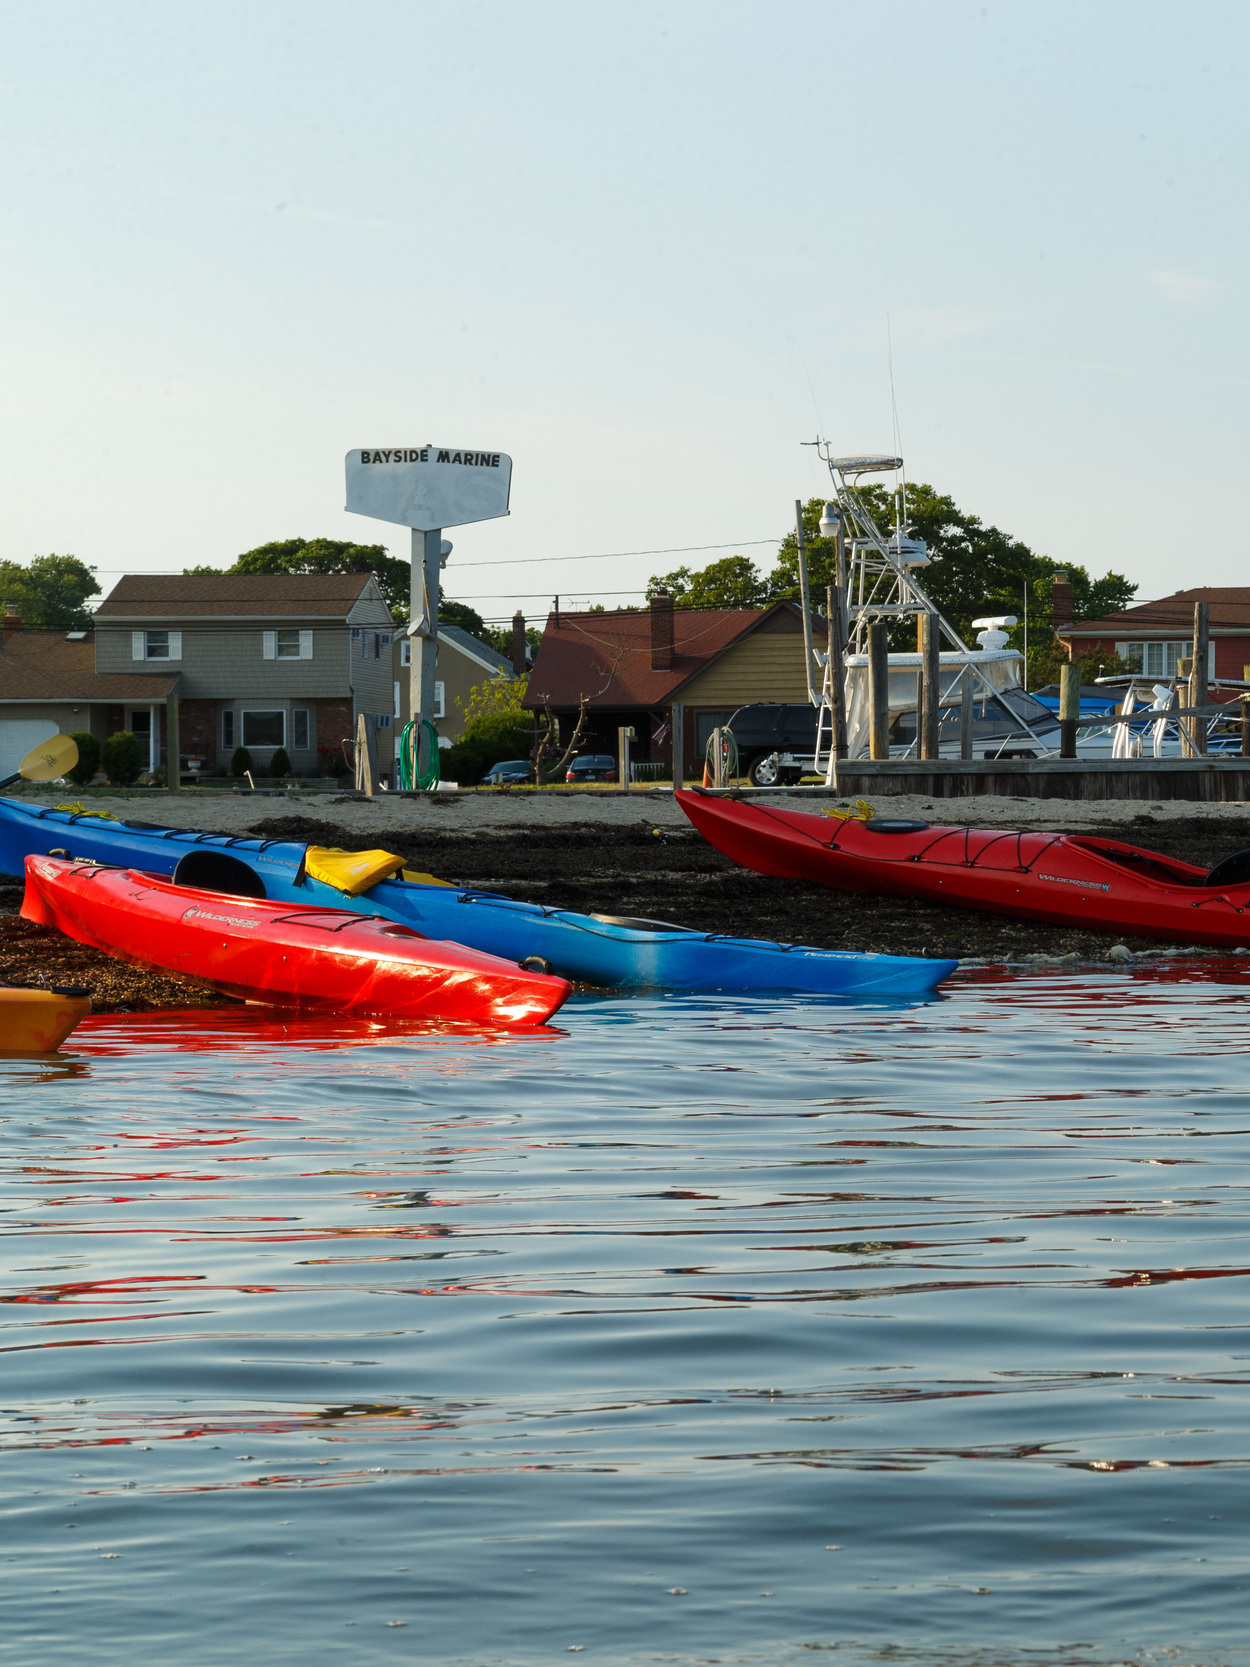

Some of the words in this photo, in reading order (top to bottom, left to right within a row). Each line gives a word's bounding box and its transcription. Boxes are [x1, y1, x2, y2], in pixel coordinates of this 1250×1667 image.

[361, 448, 429, 464] BAYSIDE
[436, 450, 500, 468] MARINE
[1039, 873, 1102, 888] WILDERNESS
[195, 910, 261, 927] WILDERNESS
[804, 952, 857, 960] TEMPEST
